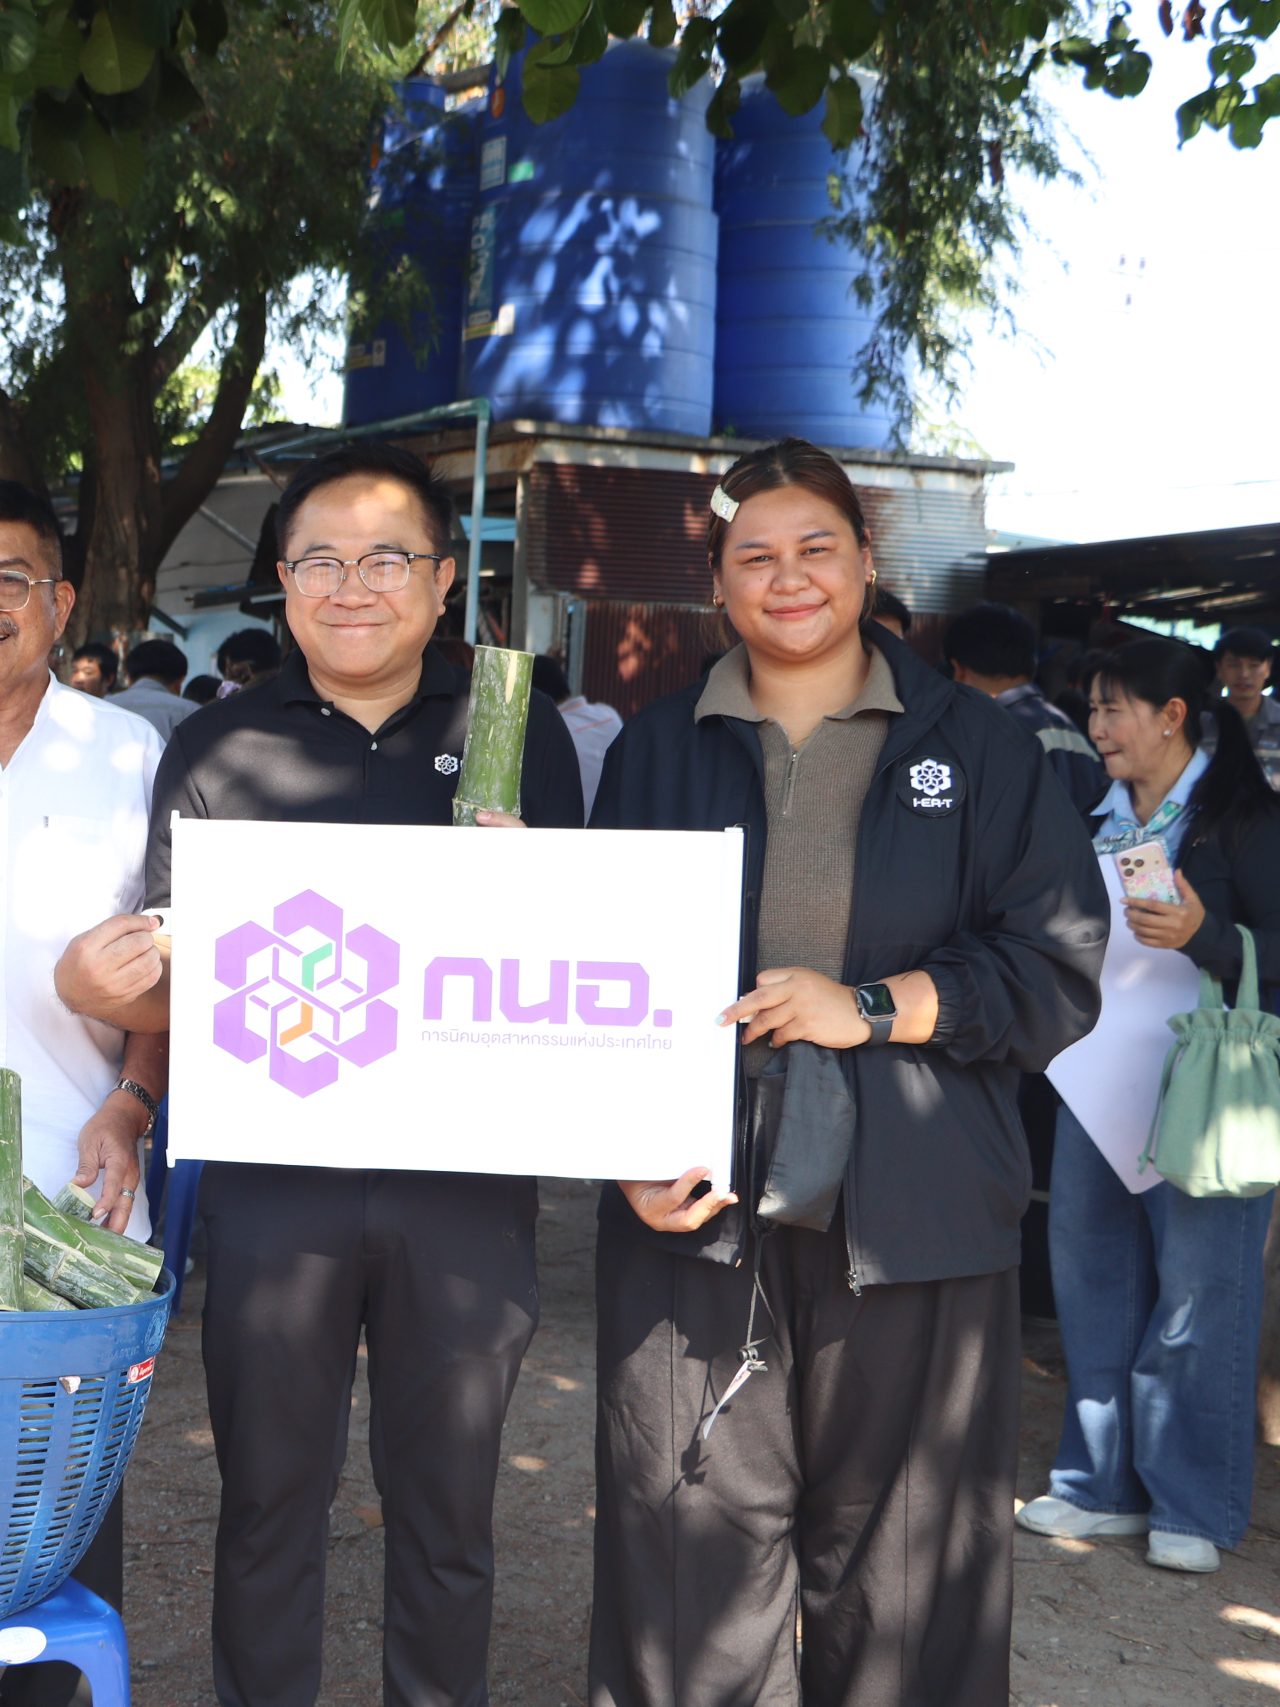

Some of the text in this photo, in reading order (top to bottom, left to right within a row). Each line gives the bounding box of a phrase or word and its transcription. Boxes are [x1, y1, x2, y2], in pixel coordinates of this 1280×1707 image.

[422, 956, 673, 1028] กนอ.
[421, 1028, 673, 1050] การนิคมอุตสาหกรรมแห่งประเทศไทย
